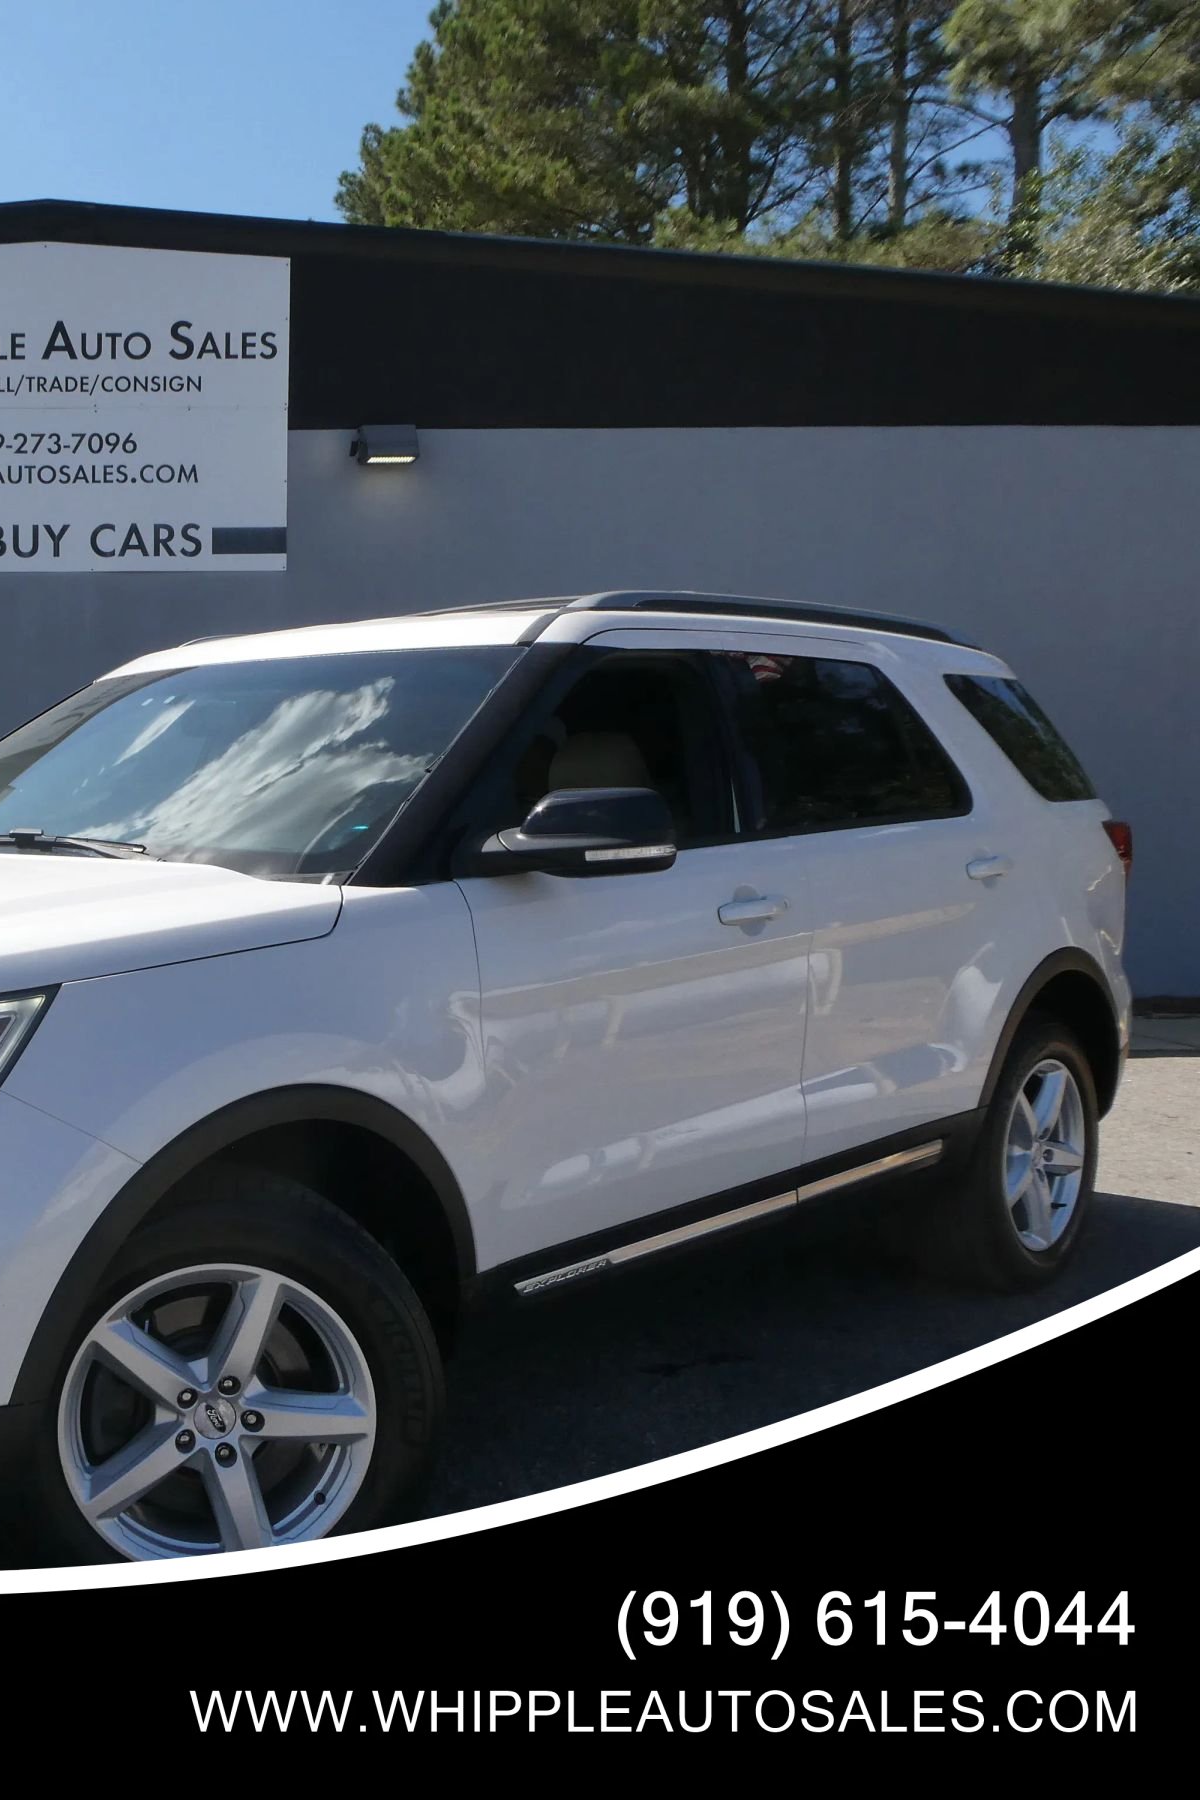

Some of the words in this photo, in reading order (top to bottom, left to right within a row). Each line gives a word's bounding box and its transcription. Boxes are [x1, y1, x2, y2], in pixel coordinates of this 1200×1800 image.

[41, 319, 153, 361] AUTO
[168, 319, 278, 361] SALES
[90, 522, 203, 558] CARS
[523, 1259, 607, 1294] EXPLORER
